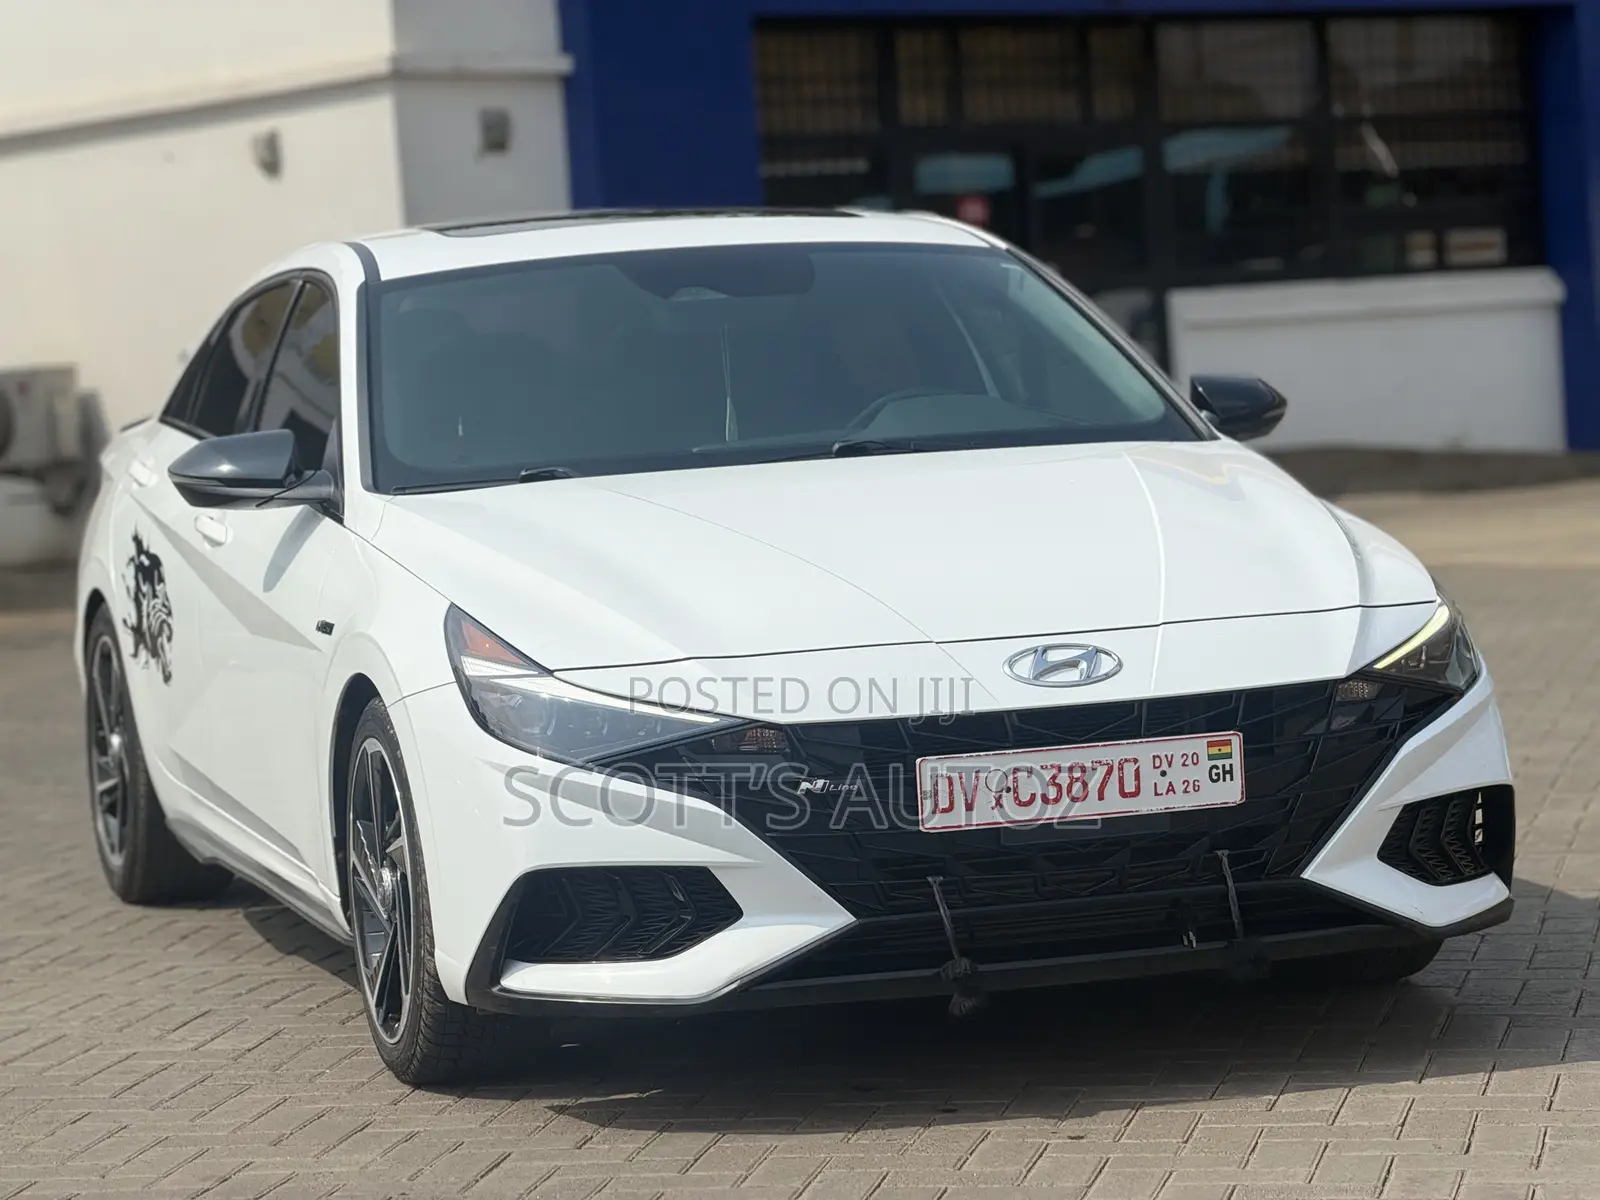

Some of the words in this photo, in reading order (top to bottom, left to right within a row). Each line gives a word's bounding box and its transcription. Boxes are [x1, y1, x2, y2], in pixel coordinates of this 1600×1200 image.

[1152, 753, 1174, 770] DV
[1181, 751, 1200, 768] 20
[1208, 762, 1235, 784] GH
[931, 769, 981, 815] DV
[1012, 756, 1142, 808] C3870
[1153, 780, 1177, 797] LA
[1181, 778, 1201, 794] 26
